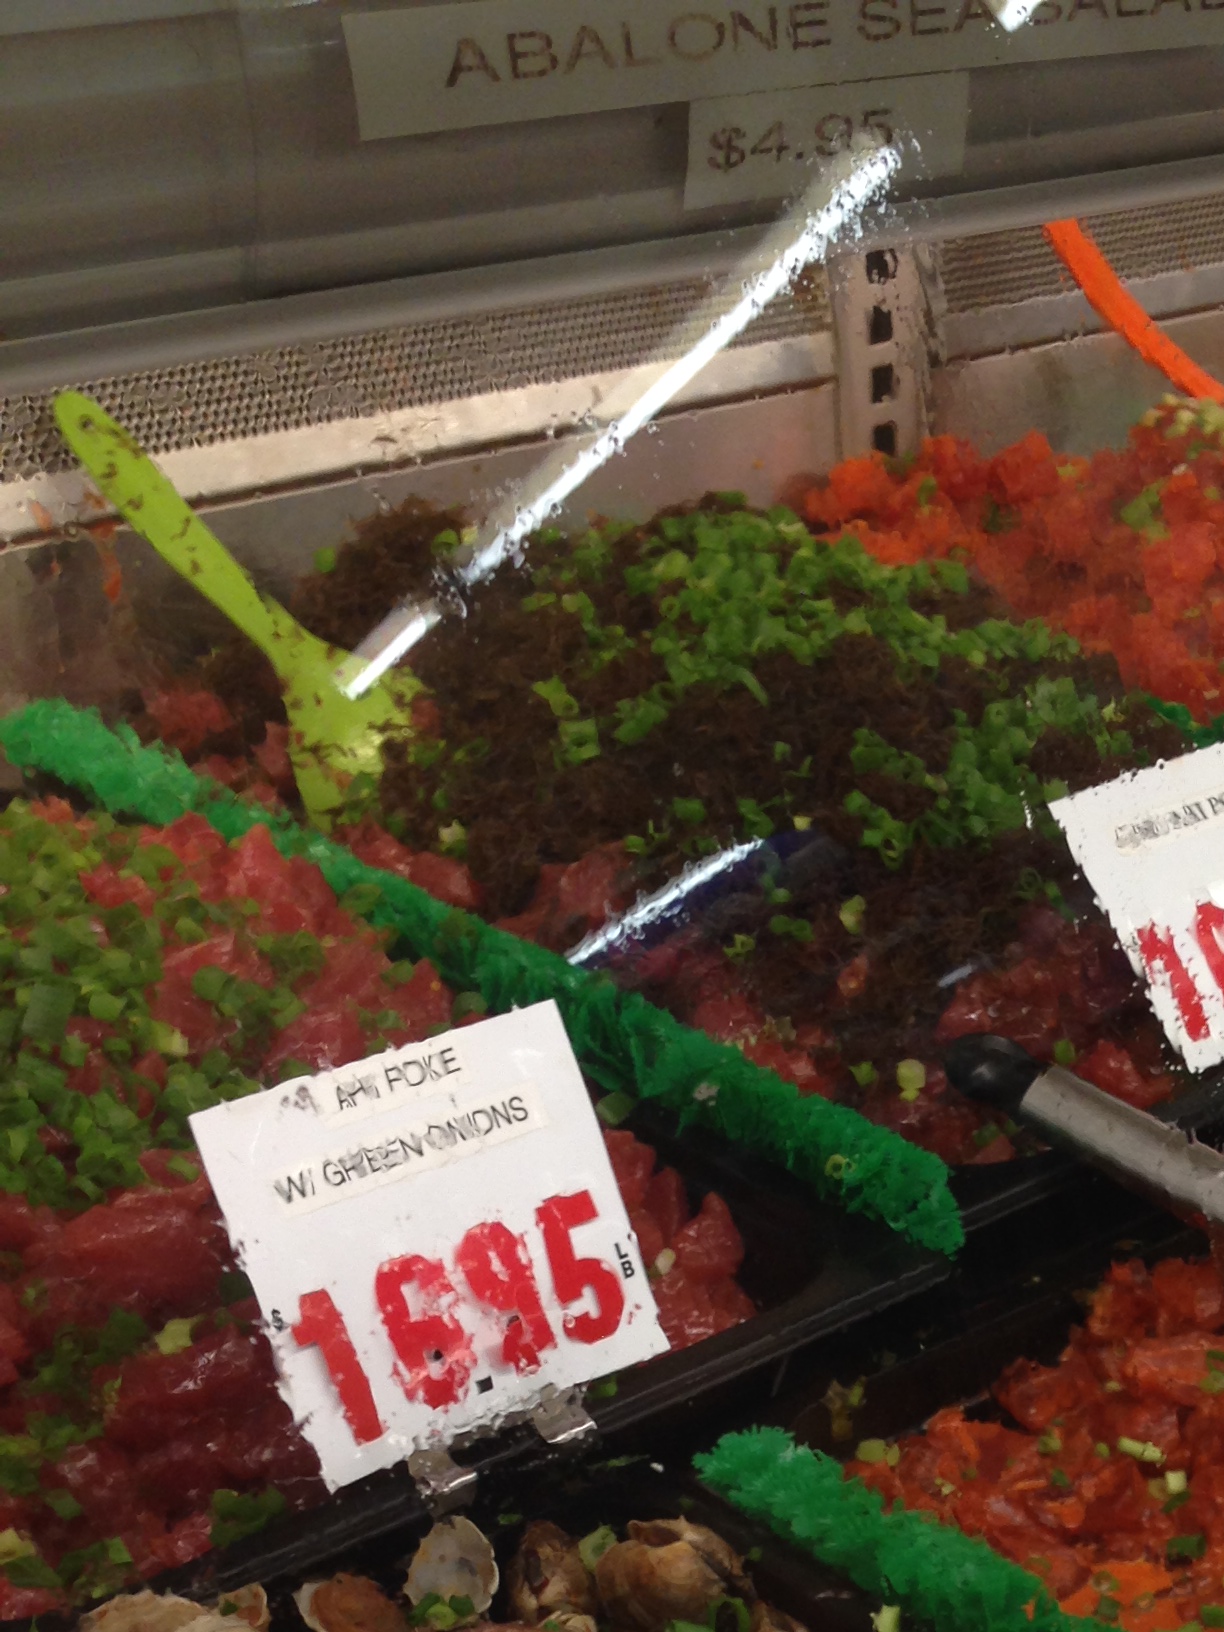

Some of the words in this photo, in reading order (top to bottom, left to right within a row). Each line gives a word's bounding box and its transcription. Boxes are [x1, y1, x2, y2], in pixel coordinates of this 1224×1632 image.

[446, 0, 831, 88] ABALONE
[707, 107, 893, 173] $4.95
[384, 1047, 462, 1092] POKE
[614, 1241, 635, 1280] LB
